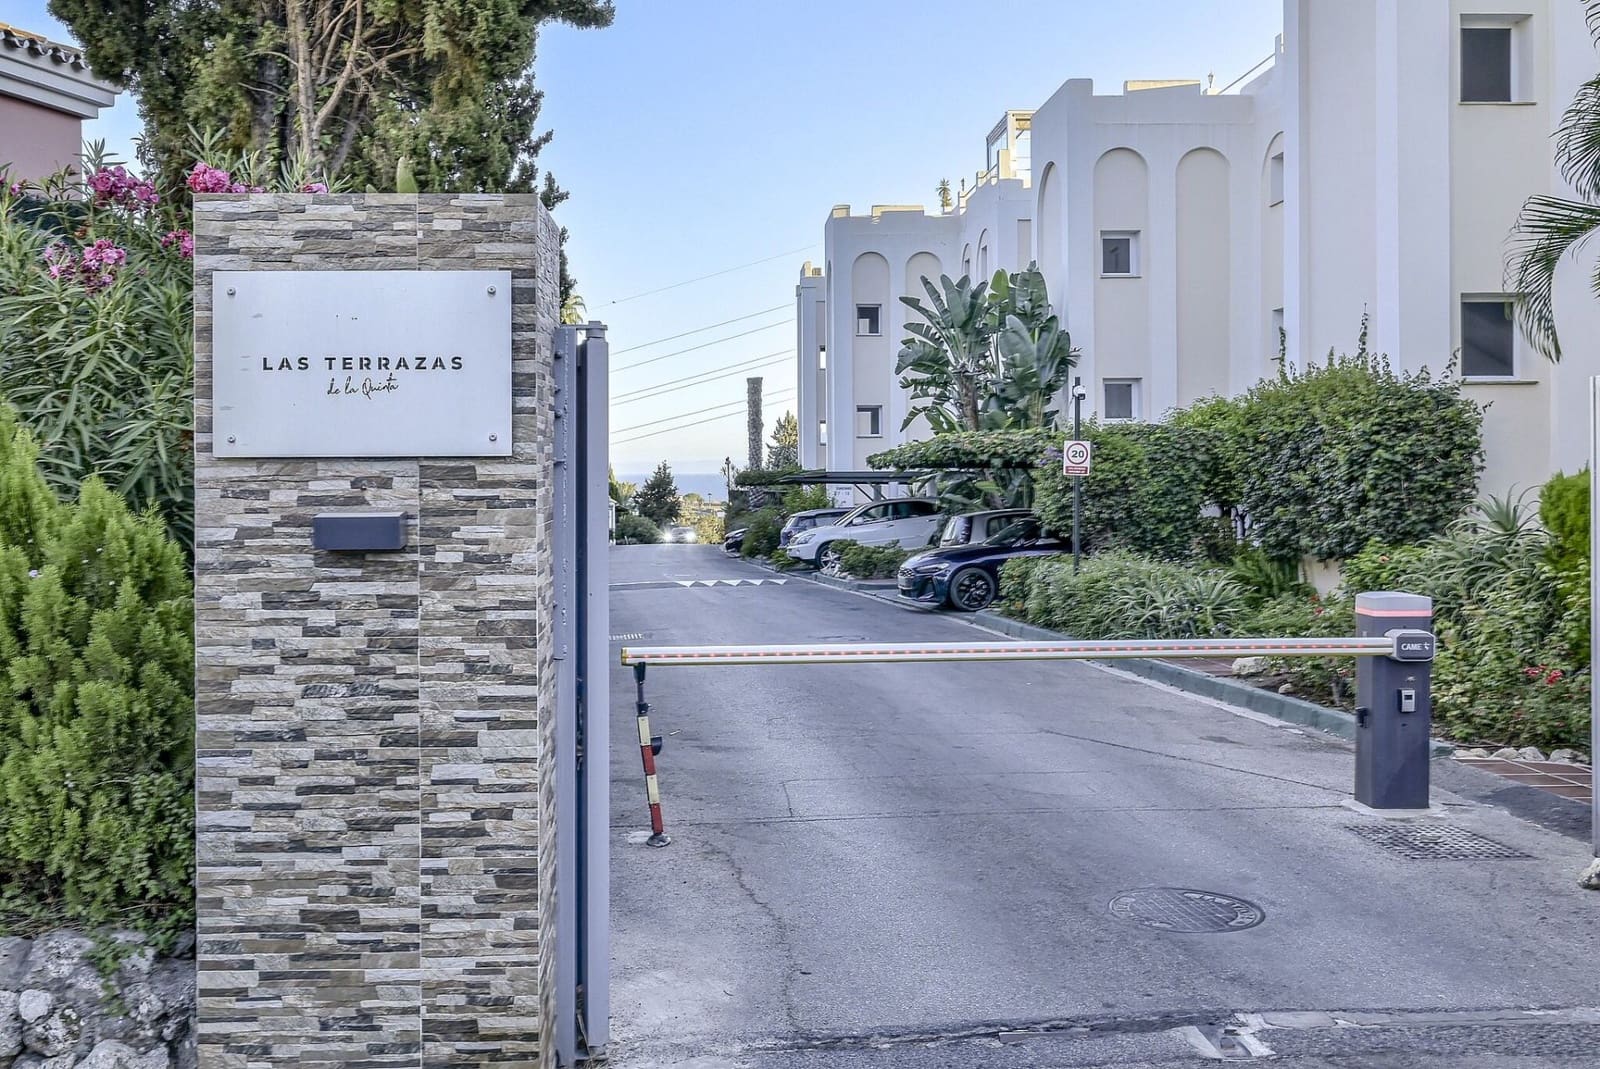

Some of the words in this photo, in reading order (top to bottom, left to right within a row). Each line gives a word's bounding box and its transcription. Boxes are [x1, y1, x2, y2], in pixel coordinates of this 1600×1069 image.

[262, 356, 310, 371] LAS
[324, 356, 464, 371] TERRAZAS
[327, 377, 341, 395] de
[344, 375, 360, 395] la
[361, 372, 400, 400] Quinta
[1071, 450, 1085, 458] 20
[1401, 643, 1423, 651] CAME
